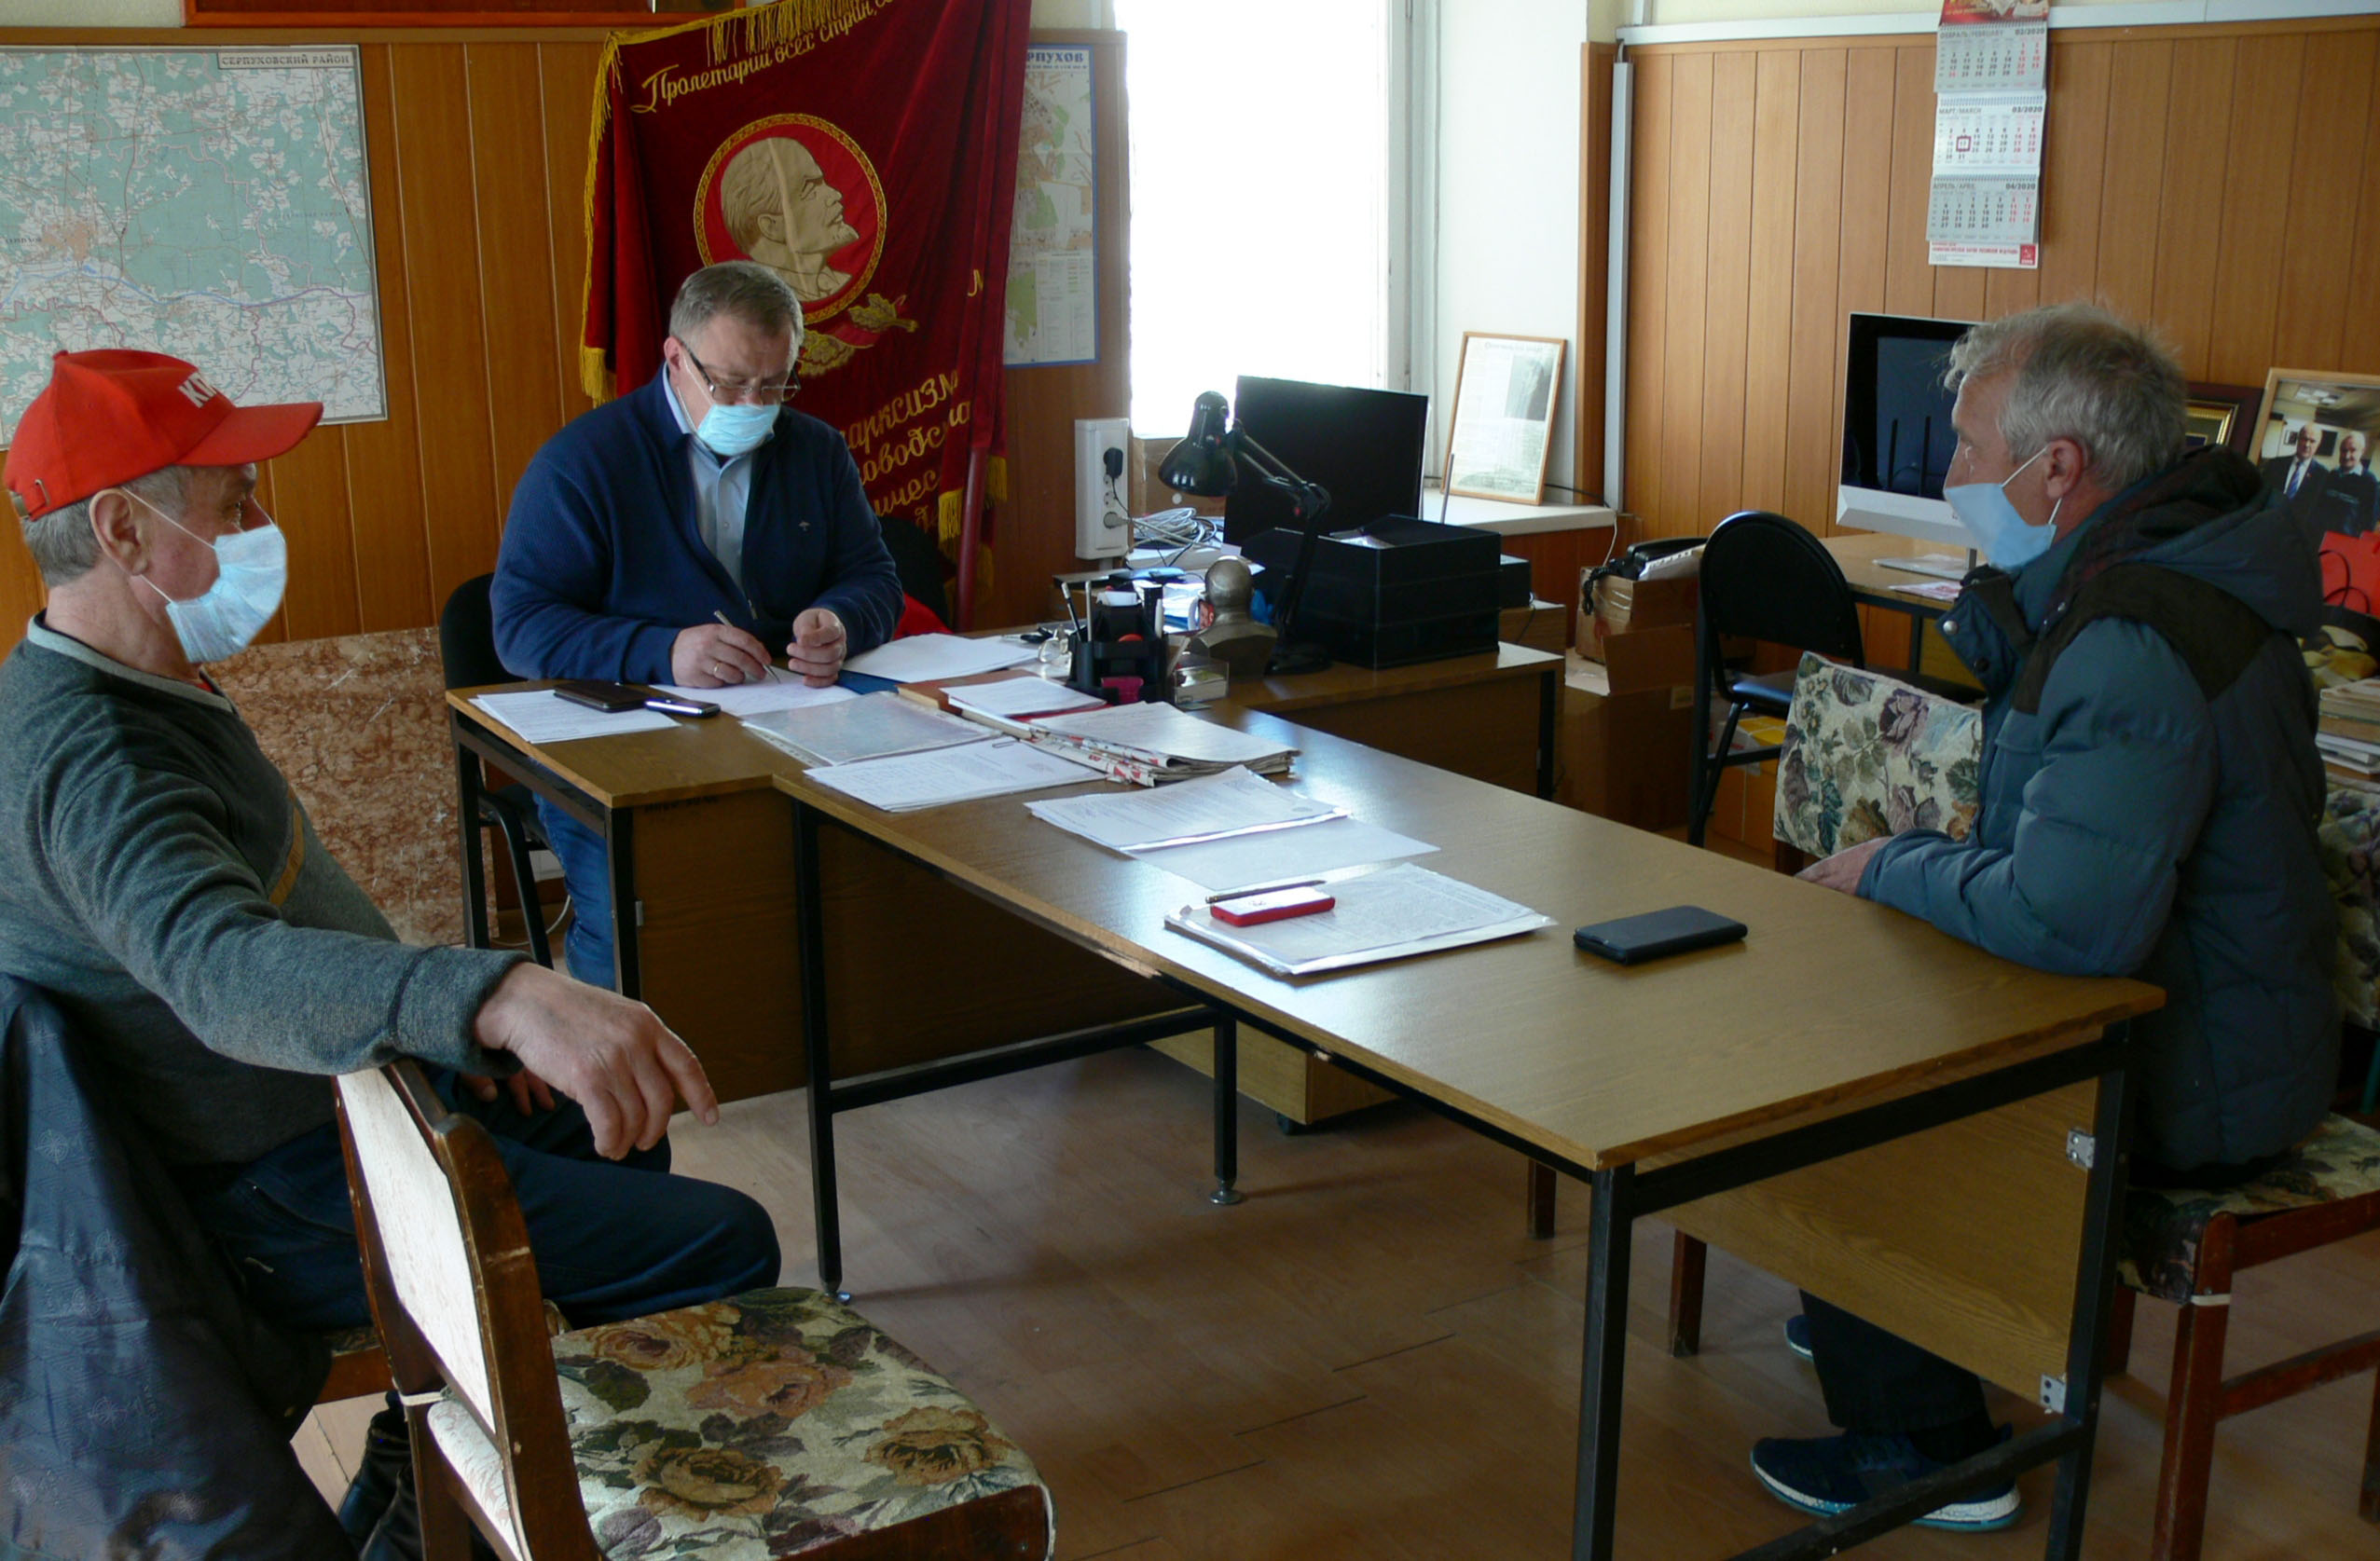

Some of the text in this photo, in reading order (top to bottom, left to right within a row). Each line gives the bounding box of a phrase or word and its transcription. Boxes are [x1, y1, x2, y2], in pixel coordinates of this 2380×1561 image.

[221, 54, 350, 65] СЕРПУХОВСКИЙ РАЙОН
[629, 54, 773, 114] Пролетарии
[775, 32, 816, 63] всех
[839, 370, 958, 455] арксизм
